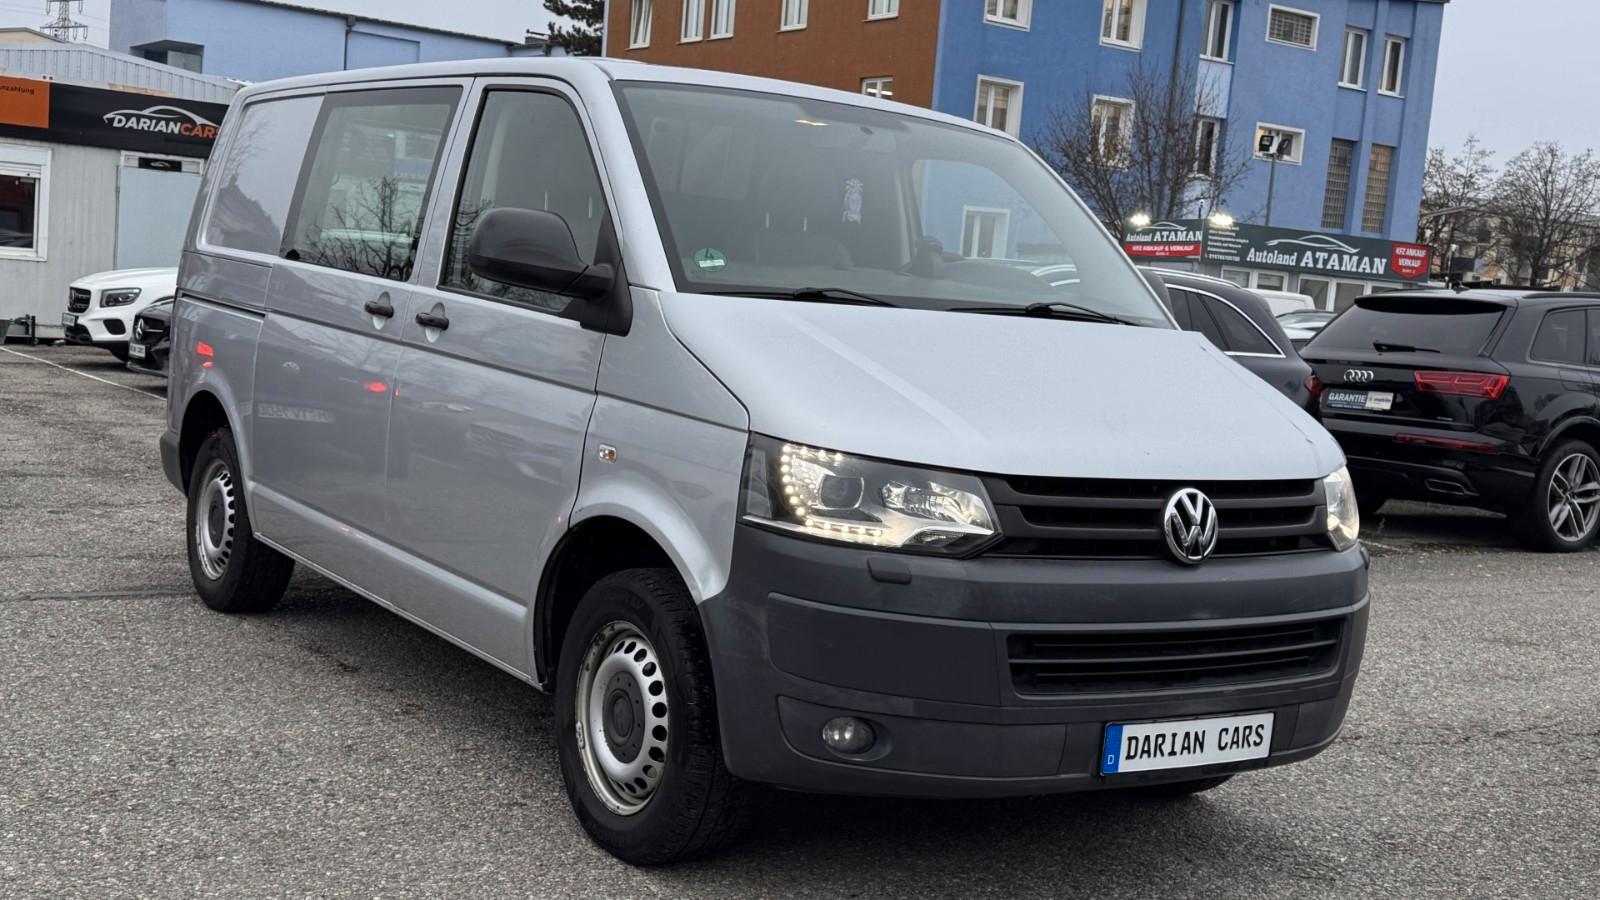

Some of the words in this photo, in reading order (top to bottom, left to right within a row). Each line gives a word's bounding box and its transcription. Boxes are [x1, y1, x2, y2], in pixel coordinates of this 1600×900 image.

[1126, 232, 1152, 241] Autoland
[1154, 230, 1203, 242] ATAMAN
[1246, 247, 1298, 266] Autoland
[1300, 250, 1387, 275] ATAMAN
[1328, 392, 1368, 403] GARANTIE
[1125, 730, 1206, 761] DARIAN
[1217, 723, 1265, 751] CARS
[1107, 754, 1115, 765] D
